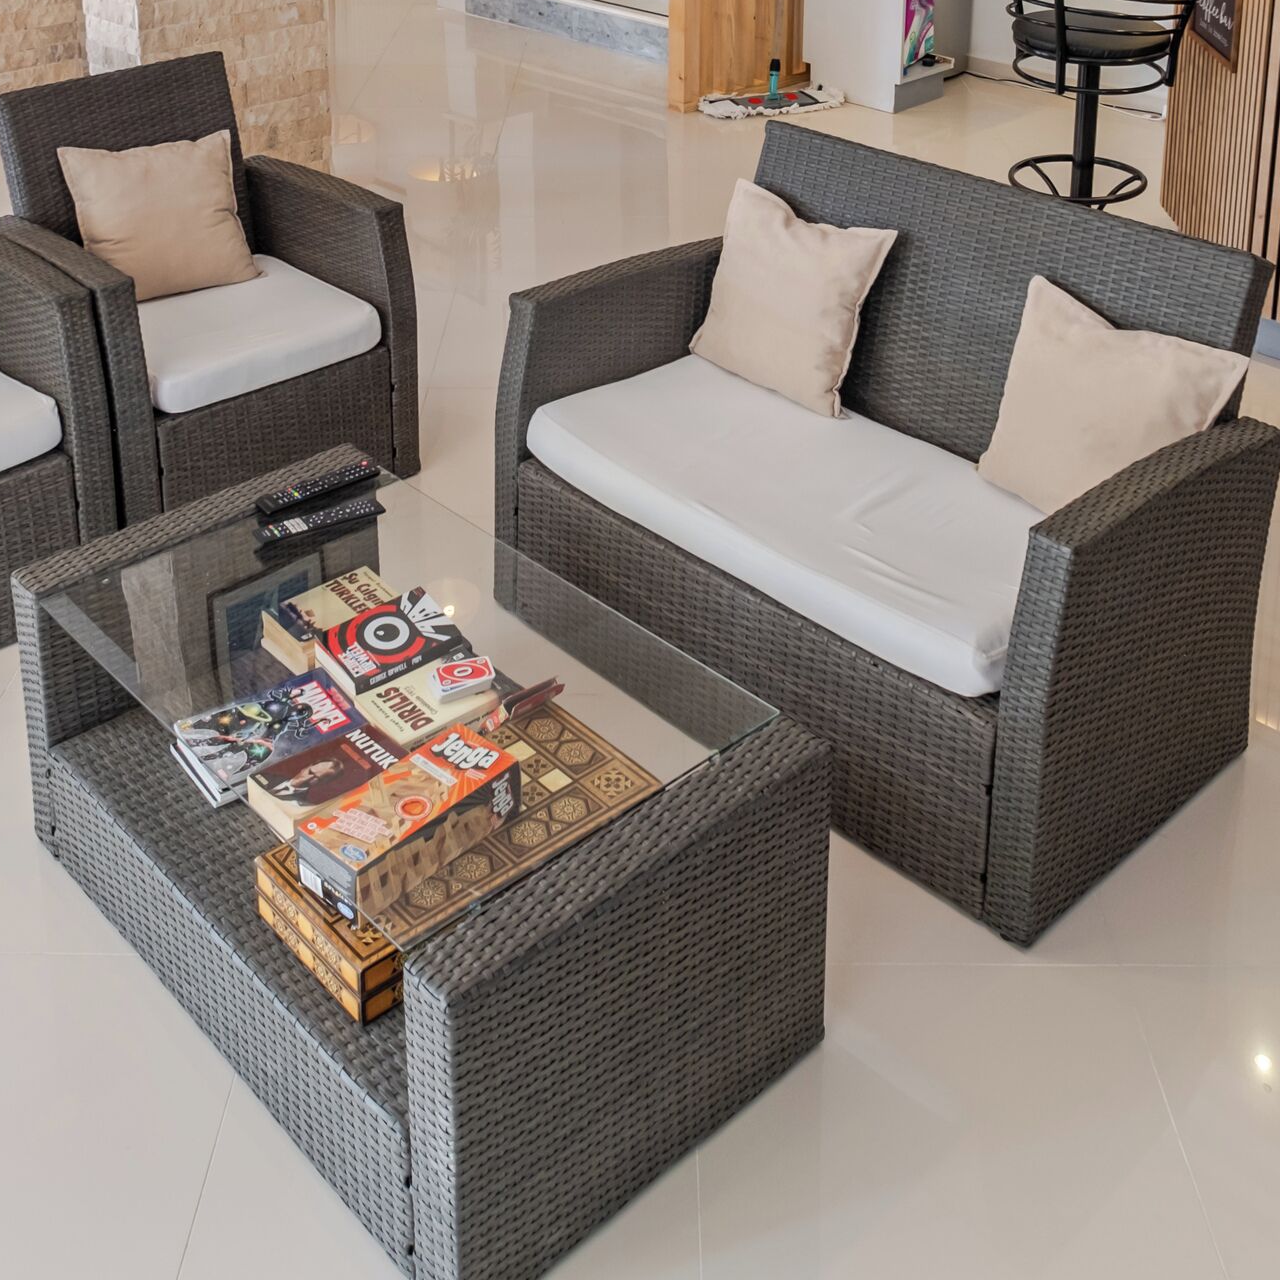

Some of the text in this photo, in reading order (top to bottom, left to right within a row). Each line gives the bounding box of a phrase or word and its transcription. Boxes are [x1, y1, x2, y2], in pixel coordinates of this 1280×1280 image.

[291, 681, 346, 731] MARVEL
[346, 728, 399, 770] NUTUK
[430, 732, 500, 769] Jenga
[491, 772, 514, 817] Jenga
